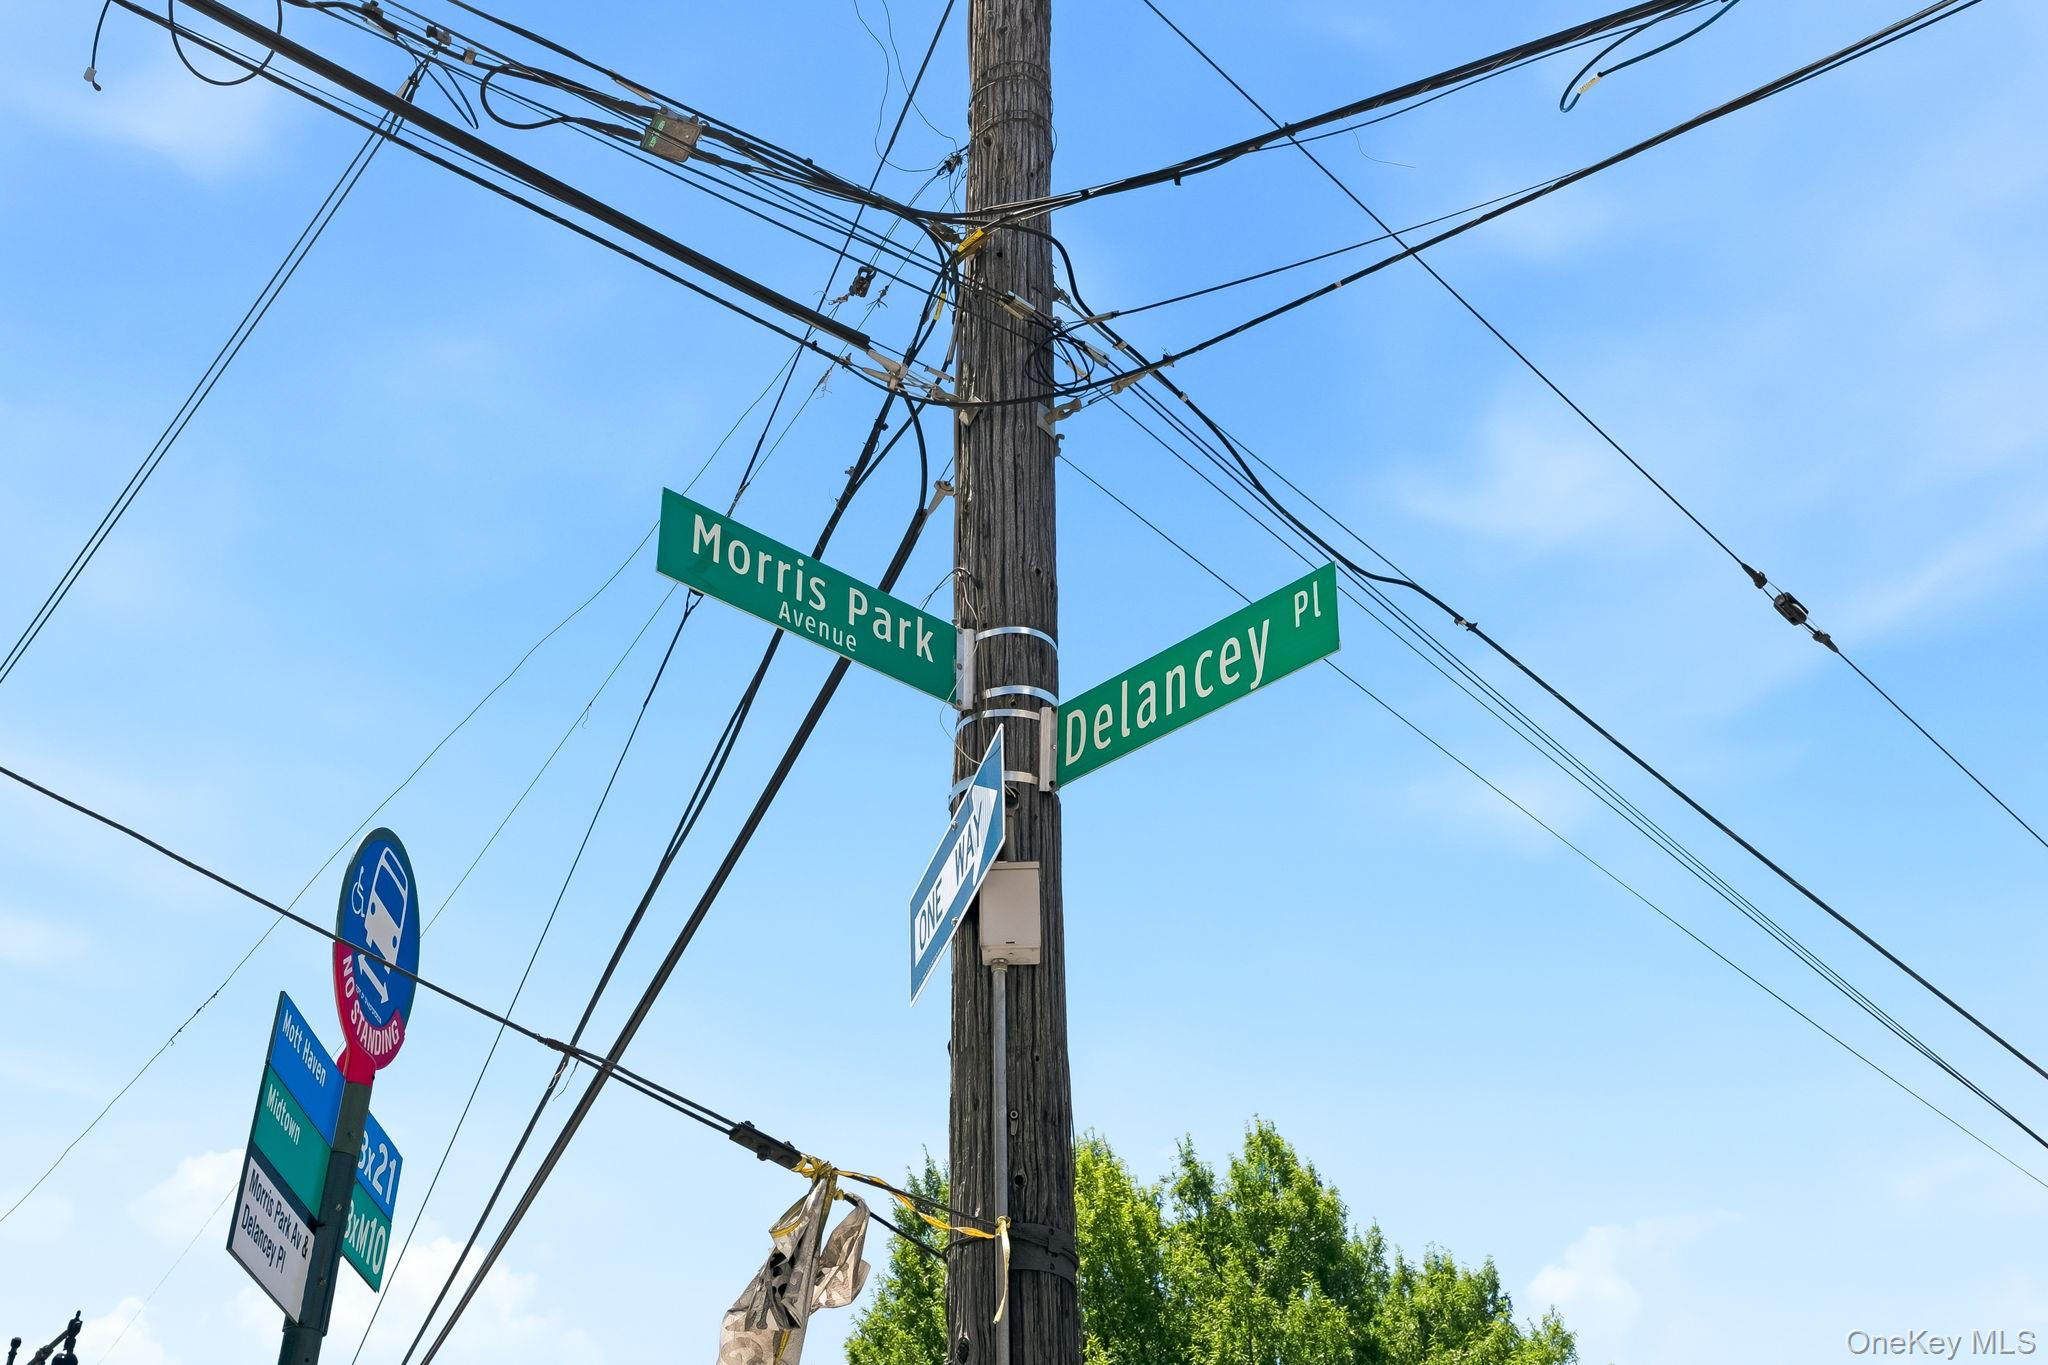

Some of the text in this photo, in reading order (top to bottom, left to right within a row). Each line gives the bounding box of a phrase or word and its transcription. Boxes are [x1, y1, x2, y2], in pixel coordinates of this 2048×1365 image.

[692, 513, 934, 663] Morris Park
[778, 601, 857, 652] Avenue
[1065, 580, 1321, 766] Delancey Pl
[919, 877, 943, 951] ONE
[954, 800, 982, 887] WAY
[282, 1009, 326, 1087] Mott Haven
[343, 955, 355, 998] NO
[350, 999, 400, 1056] STANDING
[266, 1083, 301, 1146] Midtown
[241, 1203, 287, 1274] Delancey Pl
[249, 1168, 310, 1260] Morris Park Av &
